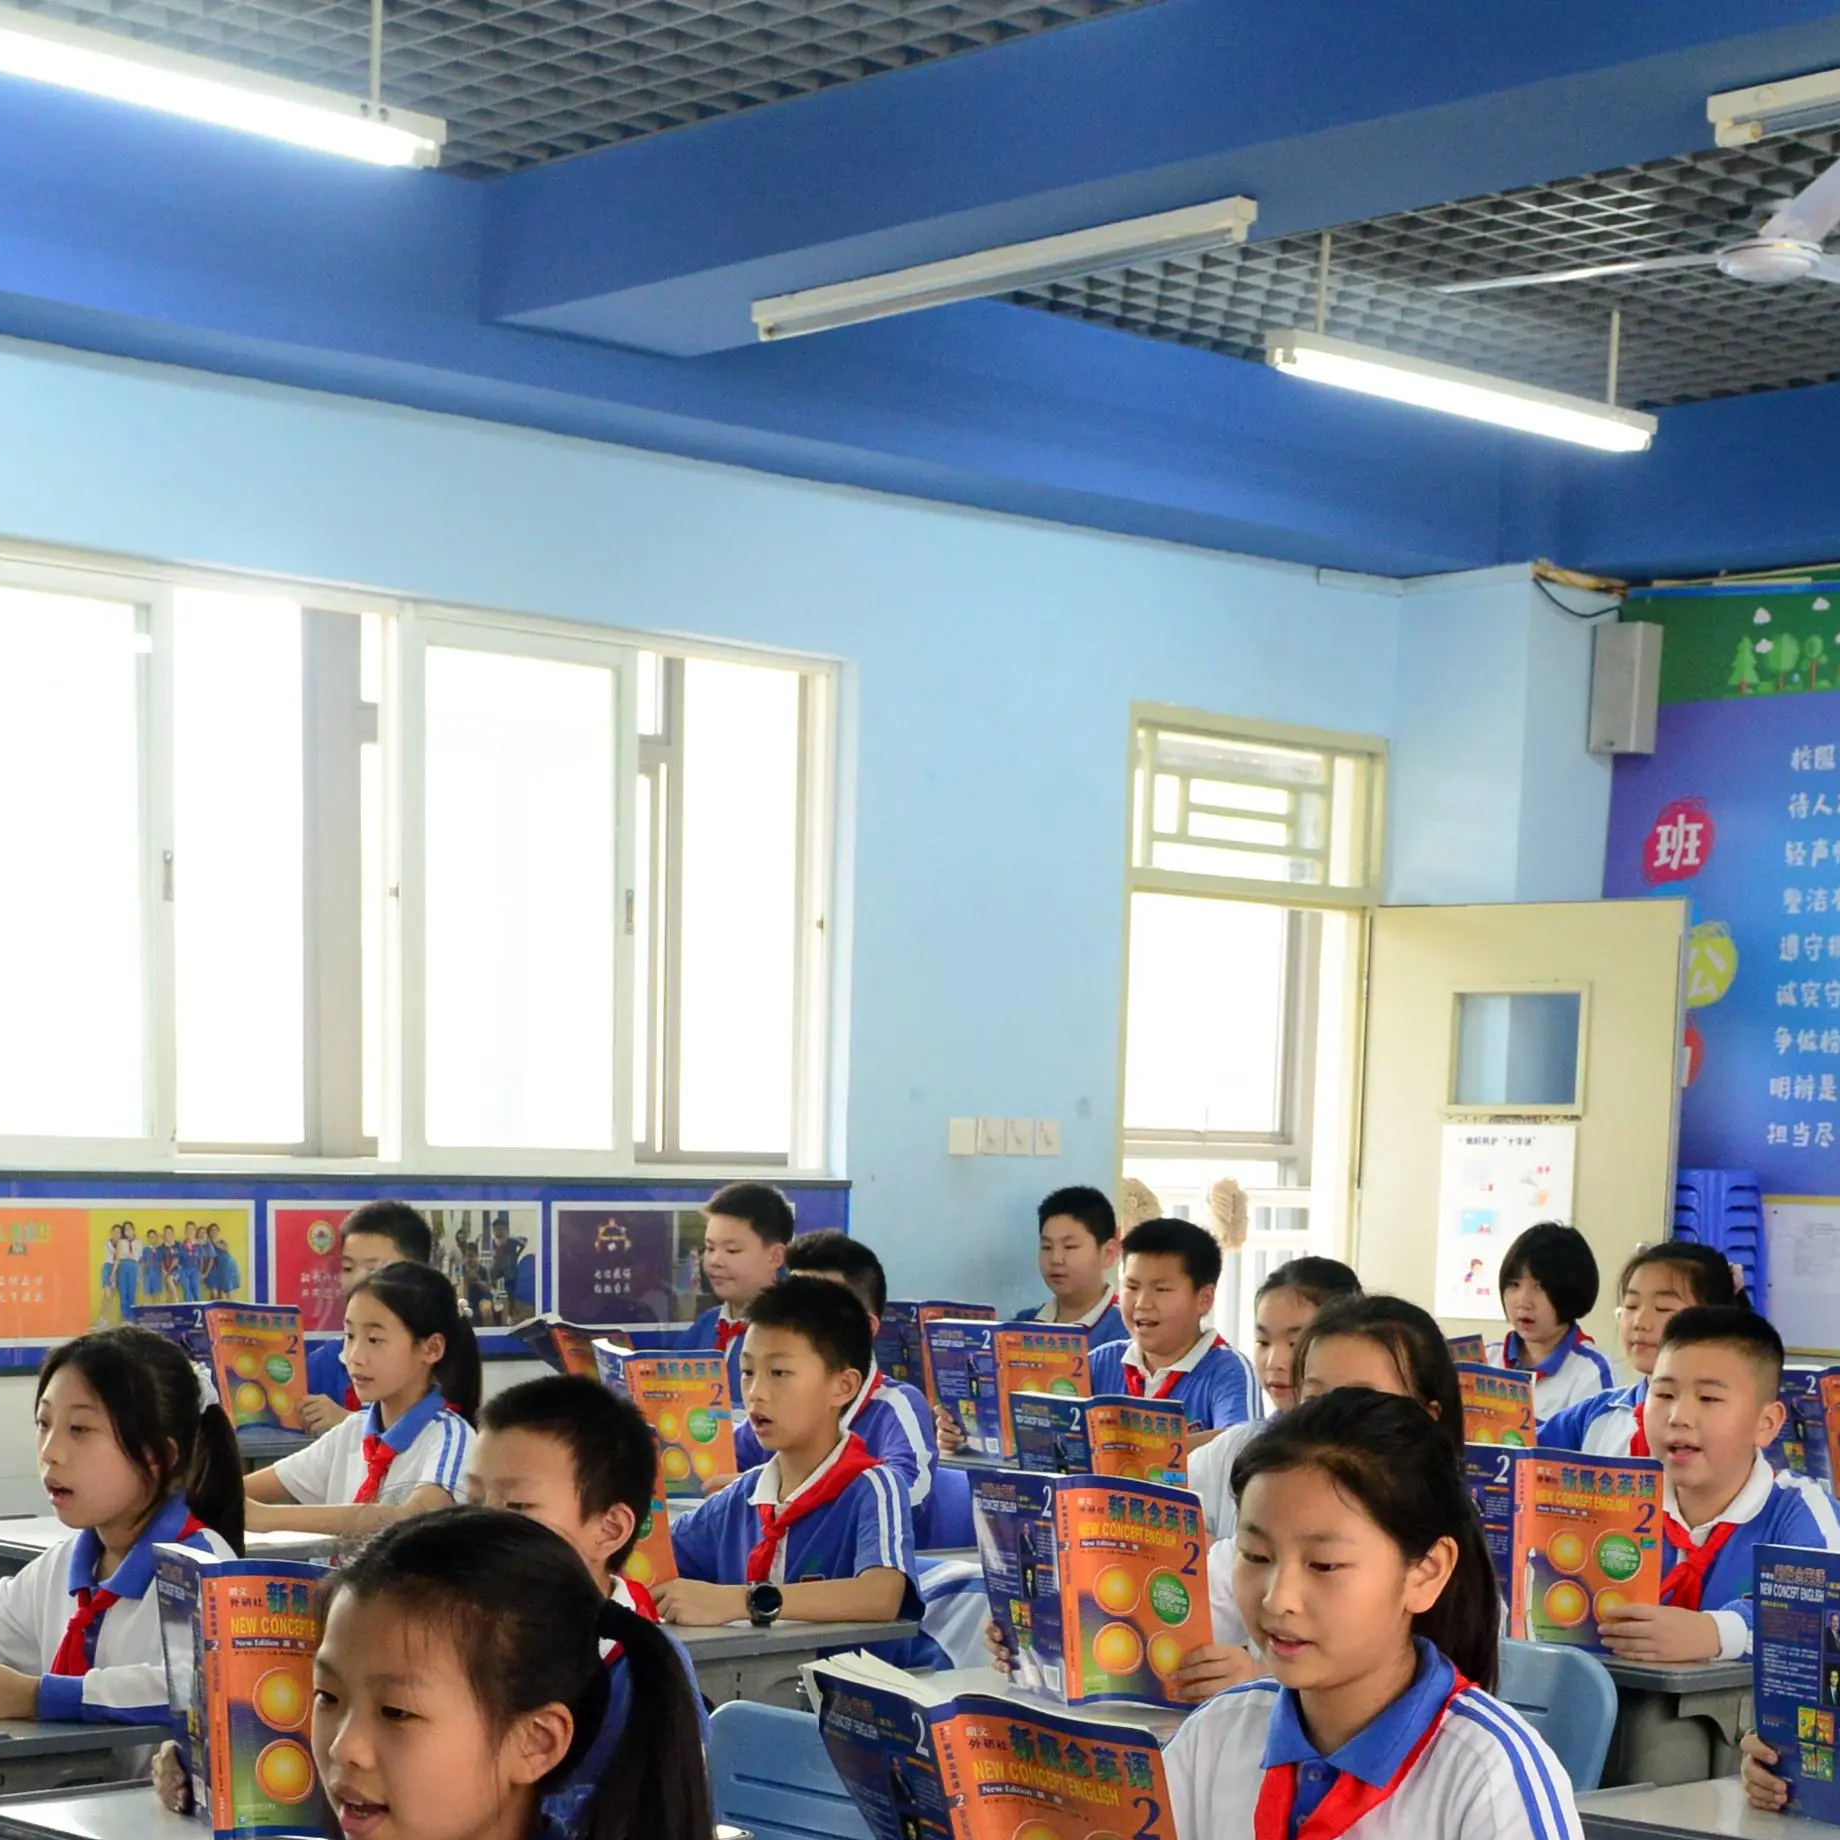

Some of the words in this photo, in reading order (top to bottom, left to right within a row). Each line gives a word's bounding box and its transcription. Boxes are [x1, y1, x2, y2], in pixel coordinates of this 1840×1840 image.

[1653, 814, 1703, 870] 班
[192, 1308, 203, 1328] 2
[286, 1335, 298, 1354] 2
[981, 1330, 991, 1350] 2
[1072, 1357, 1084, 1378] 2
[709, 1383, 724, 1406] 2
[1806, 1375, 1817, 1395] 2
[1070, 1407, 1081, 1431] 2
[1519, 1407, 1531, 1431] 2
[1168, 1444, 1183, 1469] 2
[1493, 1455, 1510, 1483] 2
[1042, 1485, 1052, 1518] 2
[1633, 1502, 1655, 1534] 2
[1181, 1541, 1200, 1576] 2
[1760, 1583, 1772, 1595] NEW
[1774, 1584, 1800, 1600] CONCEPT
[1800, 1586, 1824, 1603] ENGLISH
[231, 1617, 257, 1634] NEW
[235, 1639, 252, 1647] New
[911, 1712, 930, 1757] 2
[973, 1760, 1005, 1781] NEW
[1010, 1763, 1065, 1791] CONCEPT
[1066, 1773, 1120, 1807] ENGLISH
[981, 1784, 1003, 1795] New
[955, 1794, 965, 1807] 2
